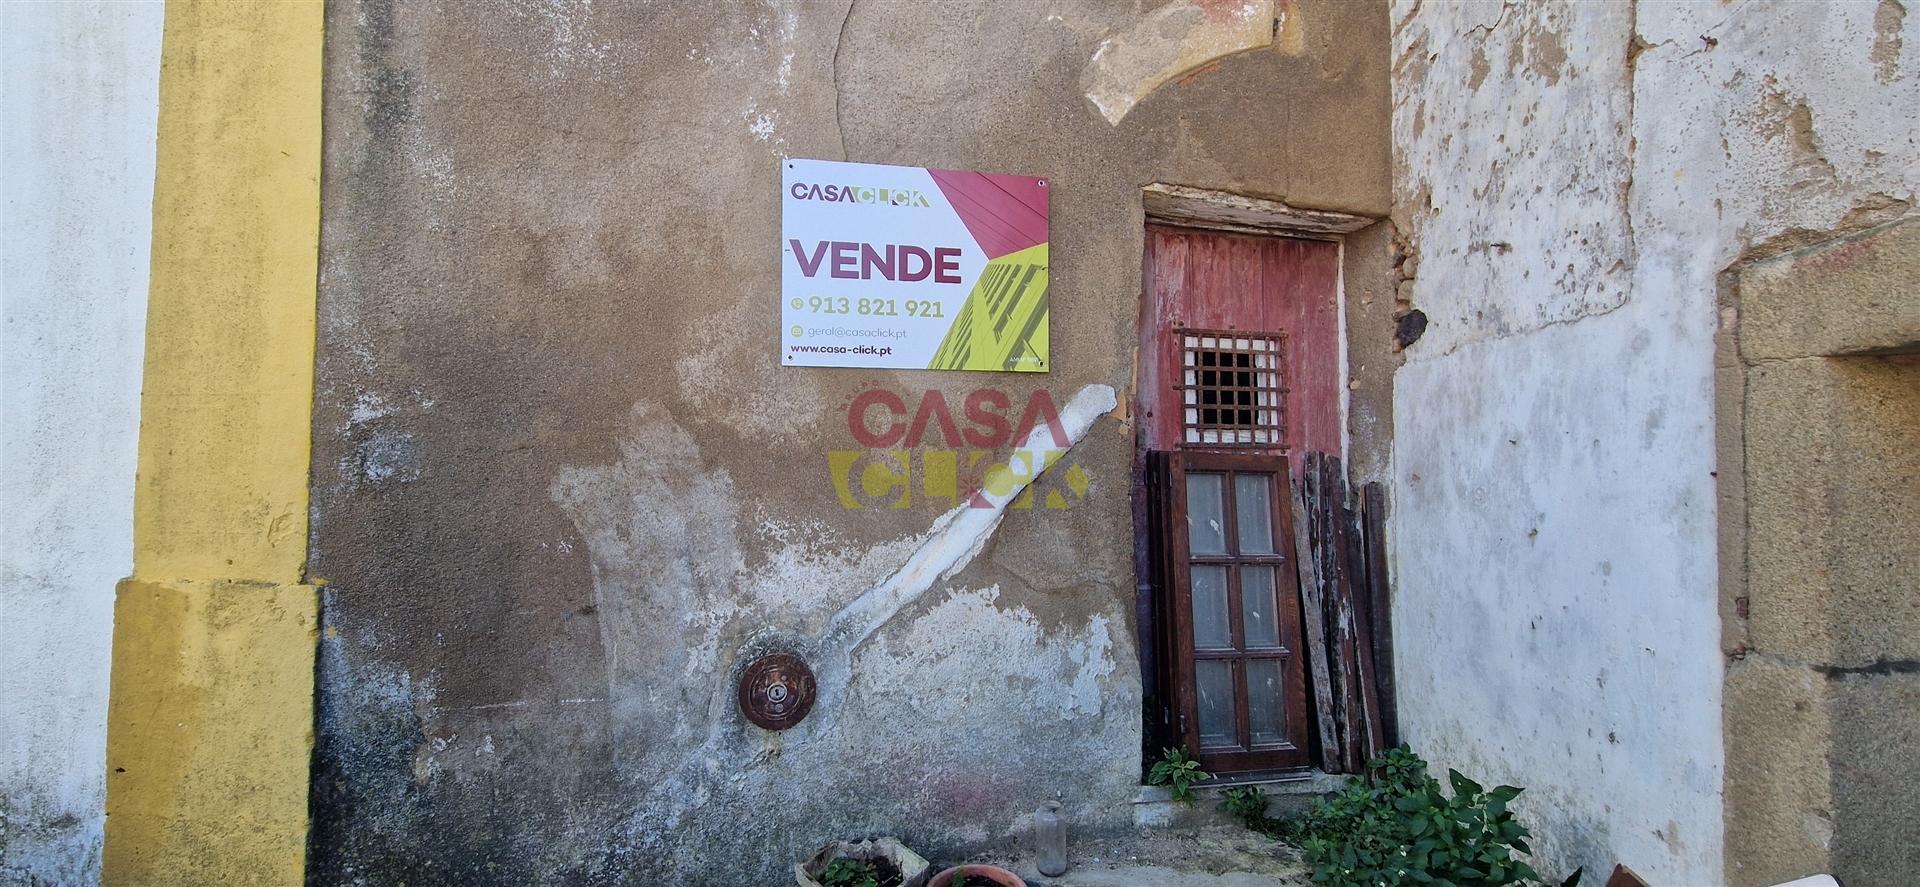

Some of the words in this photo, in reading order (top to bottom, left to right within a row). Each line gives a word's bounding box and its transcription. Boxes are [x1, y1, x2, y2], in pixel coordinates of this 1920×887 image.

[789, 239, 962, 284] VENDE
[808, 295, 850, 314] 913
[857, 298, 898, 316] 821
[905, 300, 945, 318] 921
[808, 326, 907, 340] geral@casaclick.pt
[791, 345, 892, 357] www.casa-click.pt
